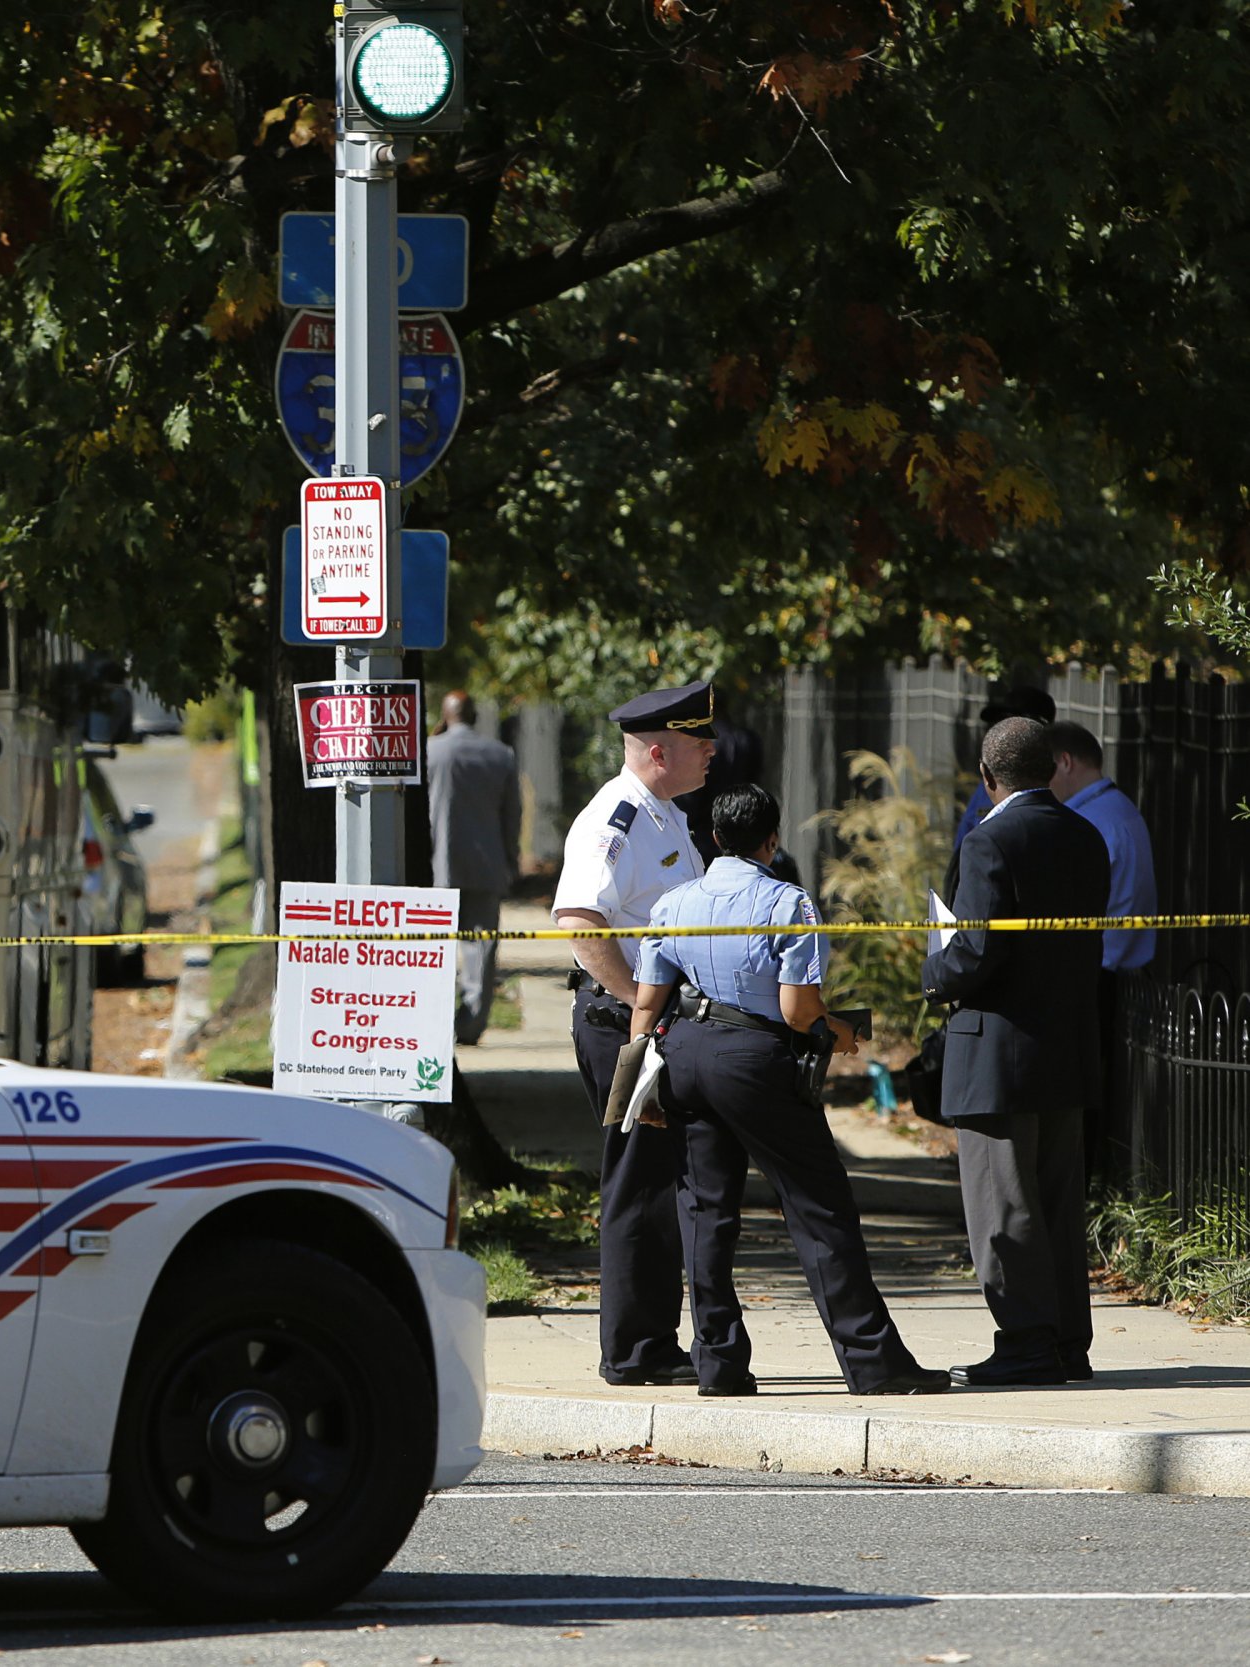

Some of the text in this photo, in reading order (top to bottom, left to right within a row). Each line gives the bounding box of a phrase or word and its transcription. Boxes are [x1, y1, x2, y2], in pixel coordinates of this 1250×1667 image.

[313, 485, 373, 499] TOW AWAY
[334, 507, 352, 521] NO
[313, 525, 372, 540] STANDING
[313, 544, 374, 560] OR PARKING
[321, 563, 370, 578] ANYTIME
[310, 618, 377, 632] IF TOWED CALL 311
[333, 684, 392, 695] ELECT
[310, 697, 410, 728] CHEEKS
[354, 727, 373, 736] FOR
[313, 735, 409, 760] CHAIRMAN
[334, 899, 405, 928] ELECT
[288, 941, 444, 969] Natale Stracuzzi
[310, 987, 417, 1008] Stracuzzi
[344, 1009, 380, 1028] For
[311, 1030, 419, 1054] Congress
[280, 1062, 407, 1080] DC Statehood Green Party
[12, 1091, 80, 1123] 126
